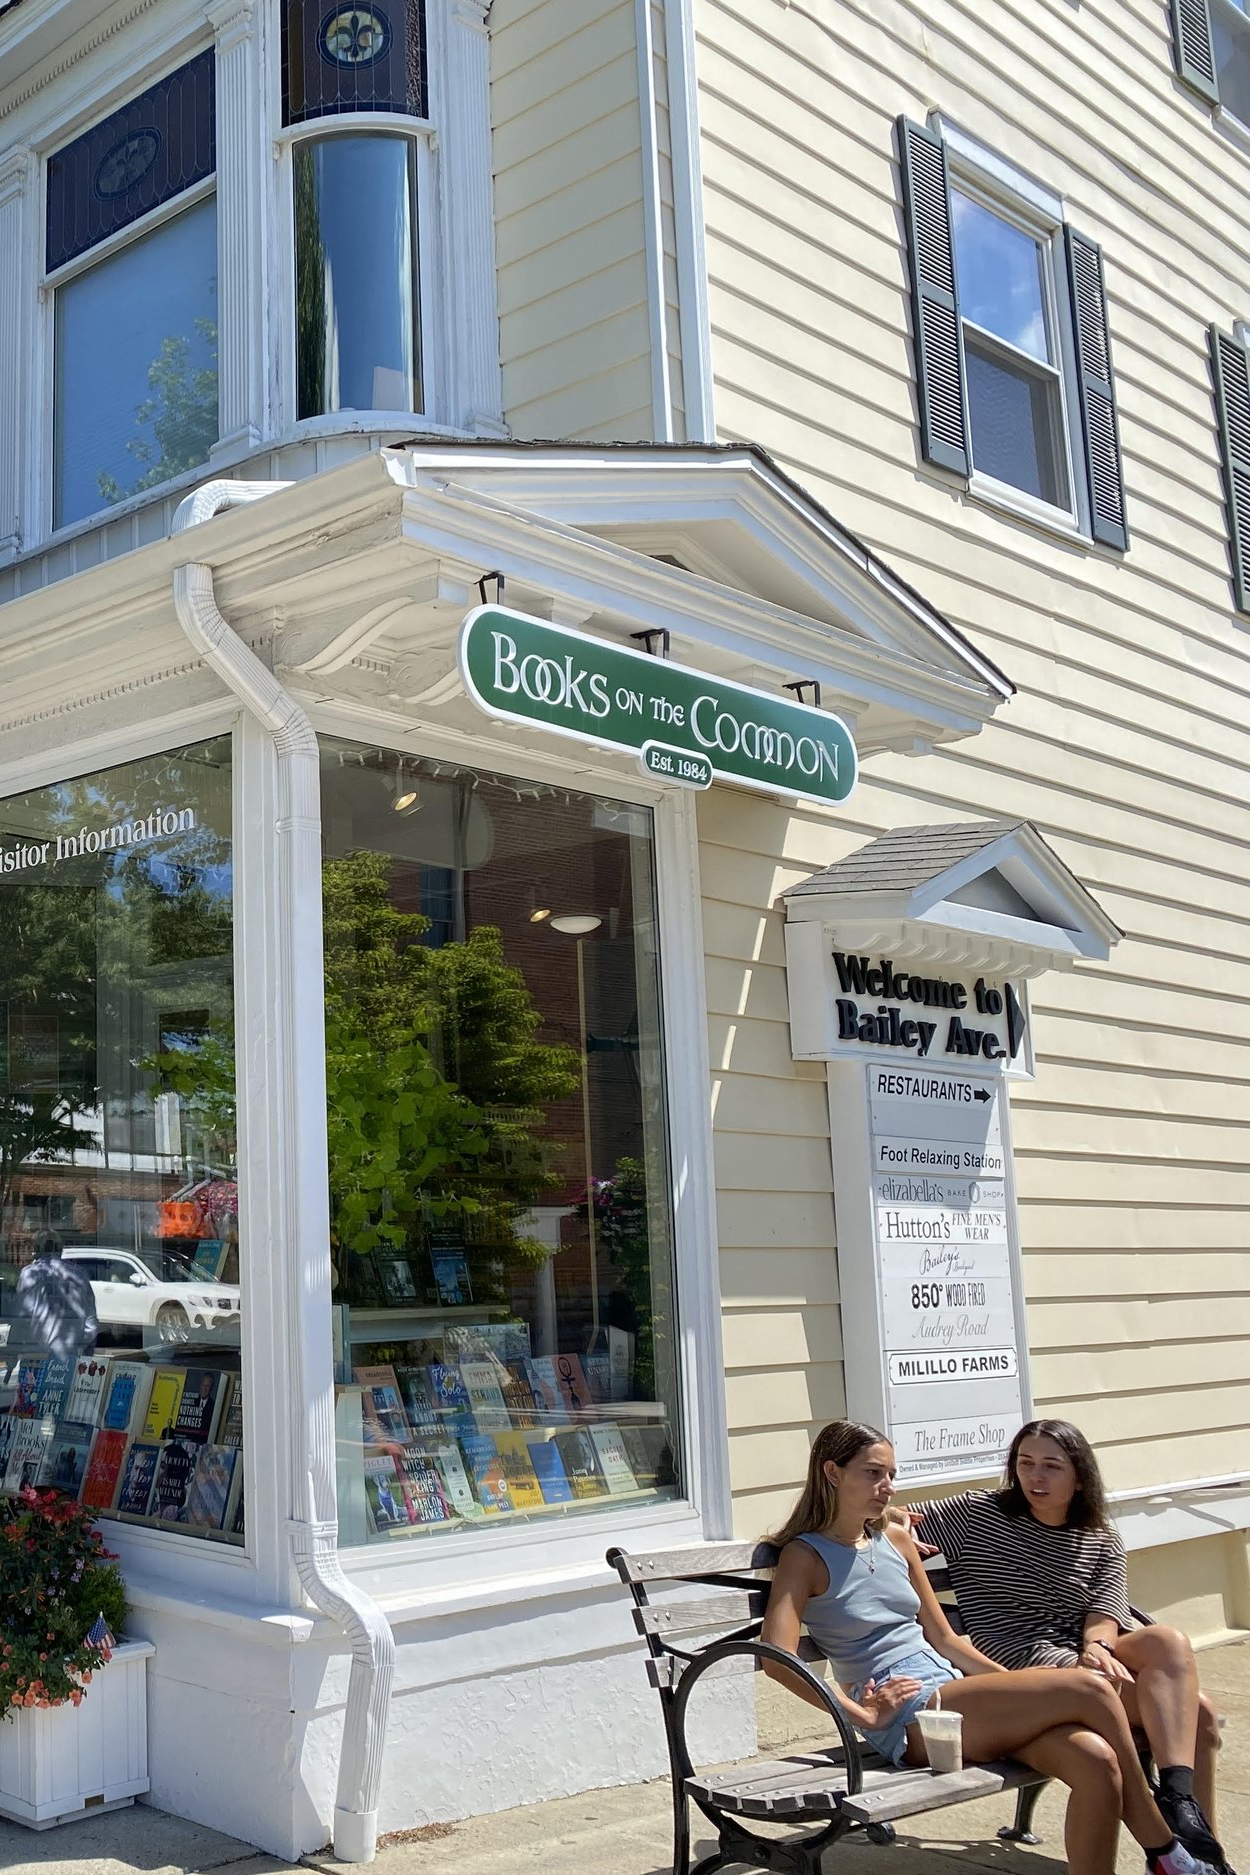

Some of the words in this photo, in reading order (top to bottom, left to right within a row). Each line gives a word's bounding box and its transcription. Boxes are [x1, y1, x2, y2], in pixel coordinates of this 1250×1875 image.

[650, 751, 674, 775] Est.
[677, 757, 708, 781] 1984
[55, 807, 196, 861] Information
[832, 952, 968, 1010] Welcome
[974, 977, 1003, 1015] to
[835, 998, 938, 1057] Bailey
[945, 1016, 1007, 1060] Ave.
[877, 1073, 972, 1103] RESTAURANTS
[880, 1145, 908, 1163] Foot
[911, 1147, 960, 1170] Relaxing
[963, 1152, 1001, 1169] Station
[882, 1177, 944, 1203] elizabella's
[947, 1189, 967, 1197] BAKE
[885, 1212, 951, 1239] Hutton's
[951, 1212, 972, 1226] FINE
[974, 1213, 1002, 1227] MEN'S
[964, 1227, 990, 1241] WEAR
[918, 1243, 960, 1276] Bailey's
[911, 1282, 943, 1310] 850°
[945, 1283, 967, 1307] WOOD
[967, 1282, 986, 1306] FIRED
[911, 1315, 955, 1346] Audrey
[956, 1313, 990, 1337] Road
[898, 1358, 957, 1377] MILILLO
[961, 1355, 1009, 1373] FARMS
[41, 1389, 64, 1403] ANNE
[439, 1383, 463, 1398] Solo
[179, 1405, 204, 1417] NOTHING
[177, 1416, 204, 1429] CHANGES
[915, 1429, 936, 1452] The
[939, 1428, 976, 1449] Frame
[978, 1423, 1006, 1448] Shop
[404, 1446, 427, 1459] MOON
[402, 1459, 426, 1472] WITCH
[409, 1469, 437, 1483] SPIDER
[899, 1463, 915, 1473] Owned
[414, 1481, 435, 1494] KING
[411, 1496, 443, 1510] MARLON
[420, 1507, 445, 1522] JAMES
